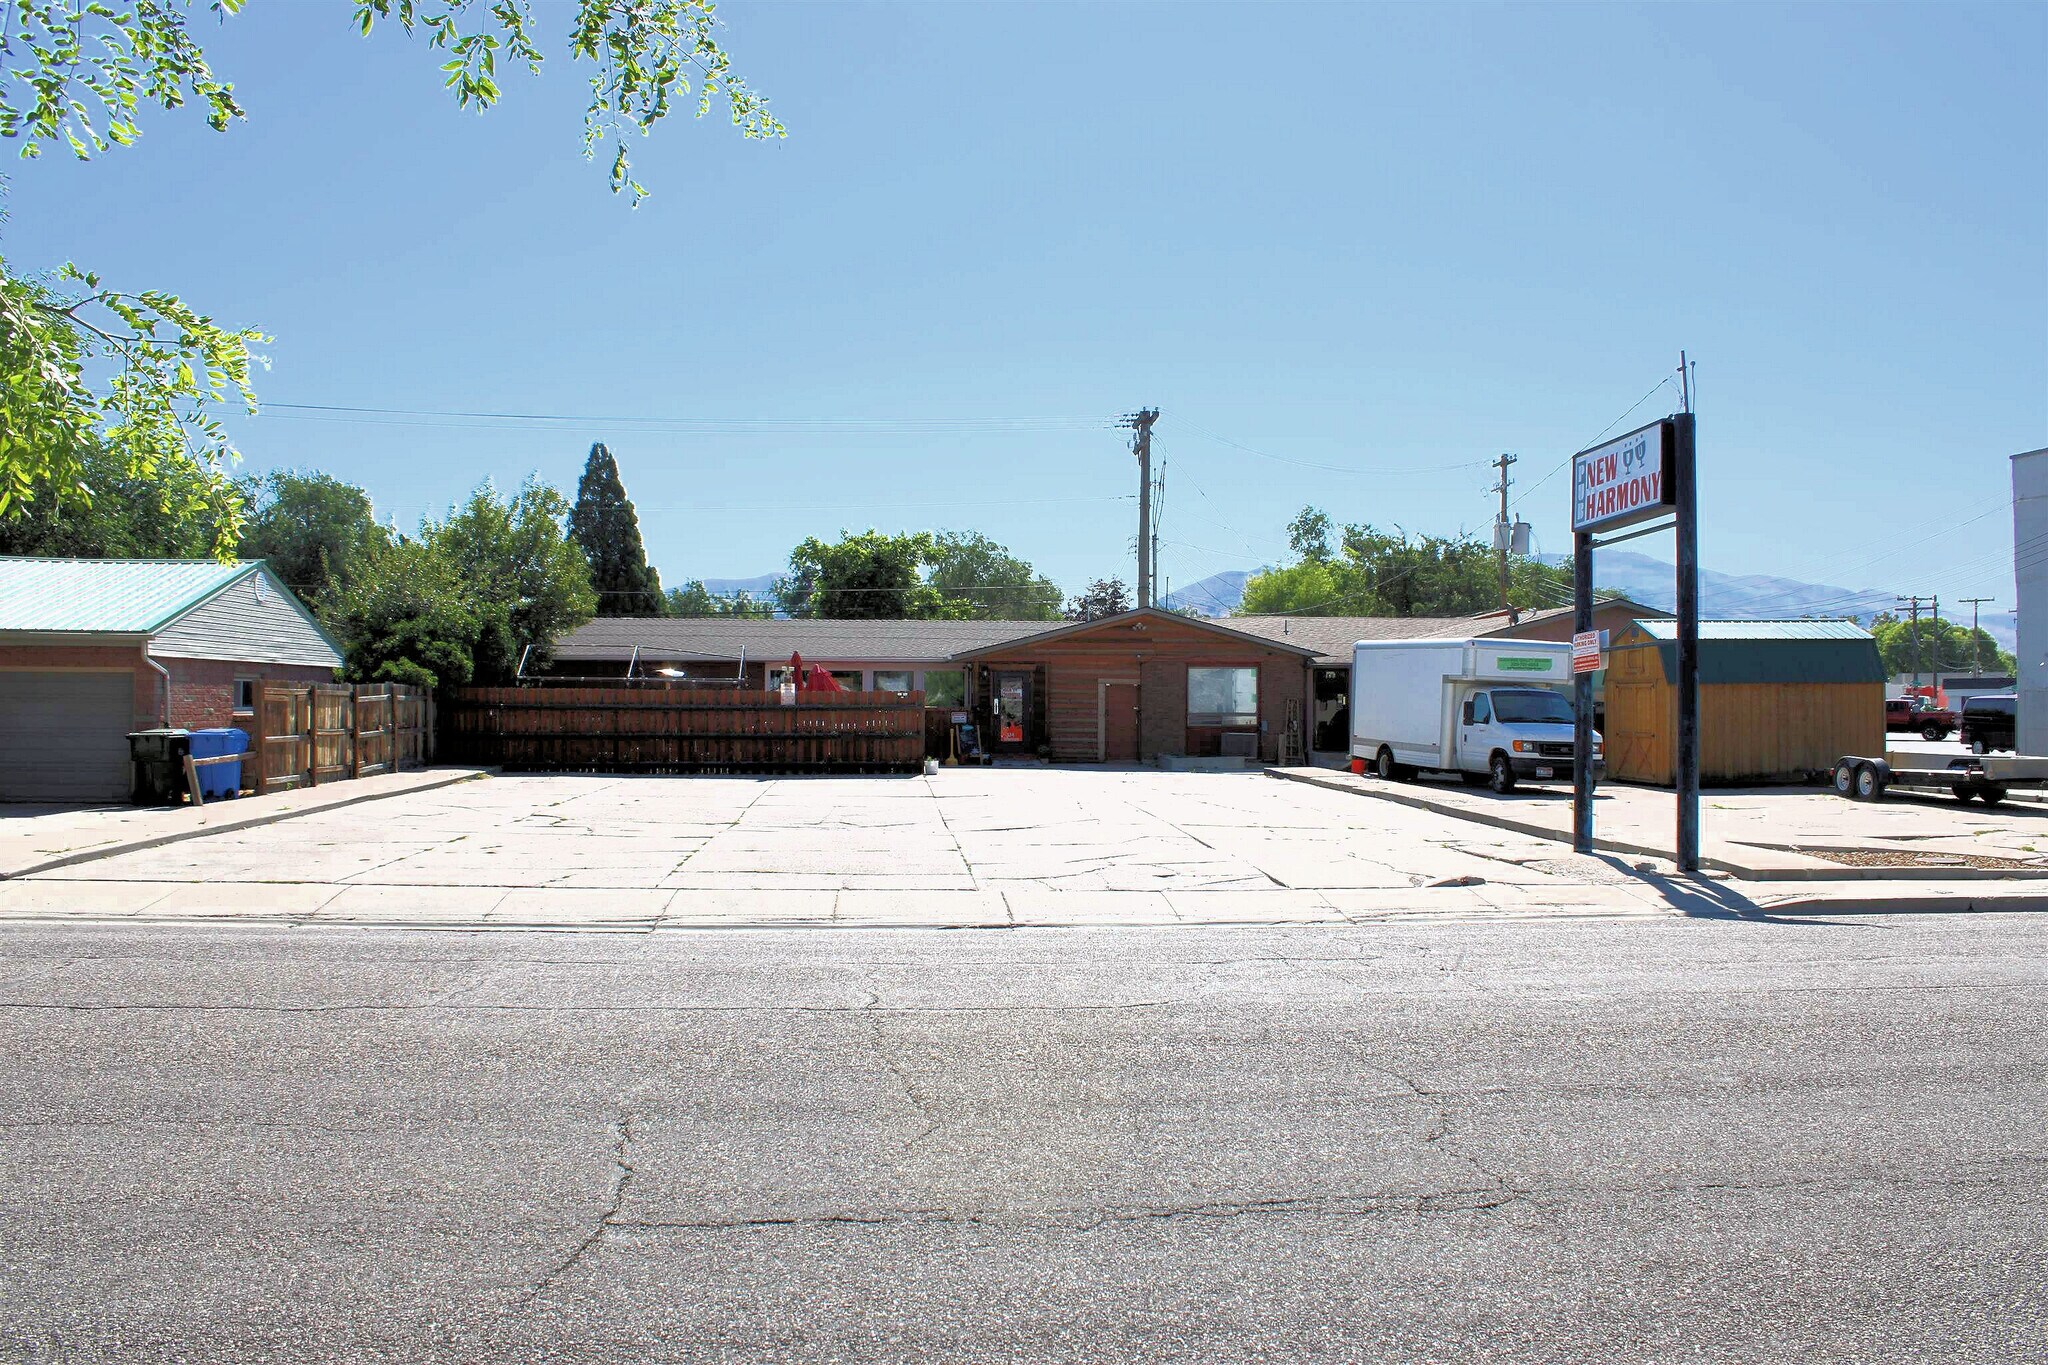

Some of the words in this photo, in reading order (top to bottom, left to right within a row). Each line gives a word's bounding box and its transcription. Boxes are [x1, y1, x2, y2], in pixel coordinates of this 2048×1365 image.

[1577, 463, 1585, 520] PUB
[1587, 452, 1618, 489] NEW
[1586, 471, 1661, 520] HARMONY
